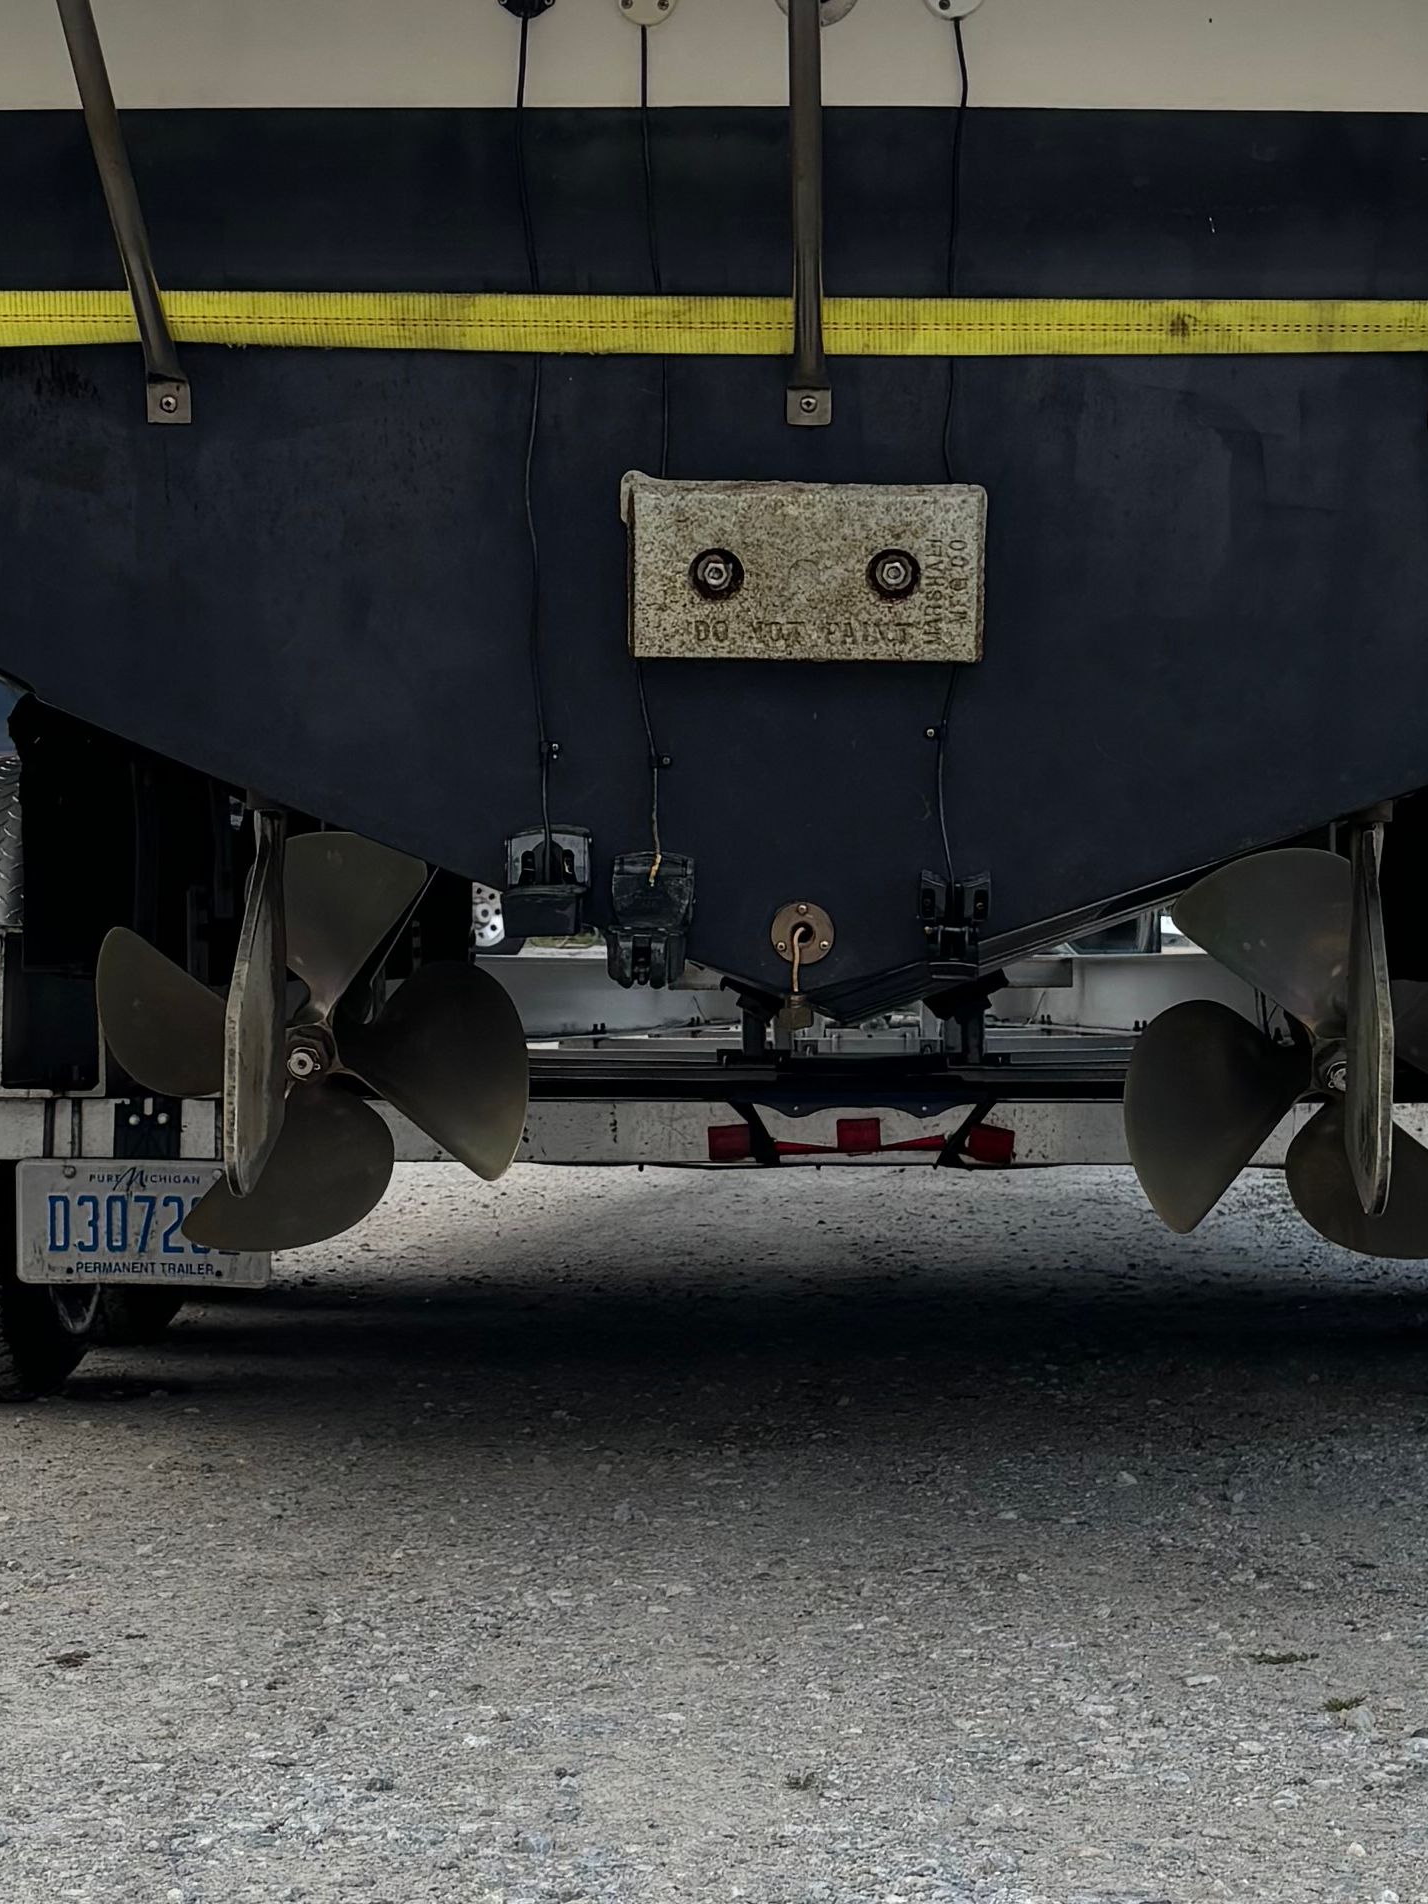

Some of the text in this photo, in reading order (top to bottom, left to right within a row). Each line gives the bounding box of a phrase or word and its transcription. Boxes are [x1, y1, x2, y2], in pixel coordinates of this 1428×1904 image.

[693, 620, 729, 643] DO
[113, 1166, 201, 1191] MICHIGAN
[48, 1195, 240, 1256] D3072
[76, 1261, 214, 1275] PERMANENT TRAILER
